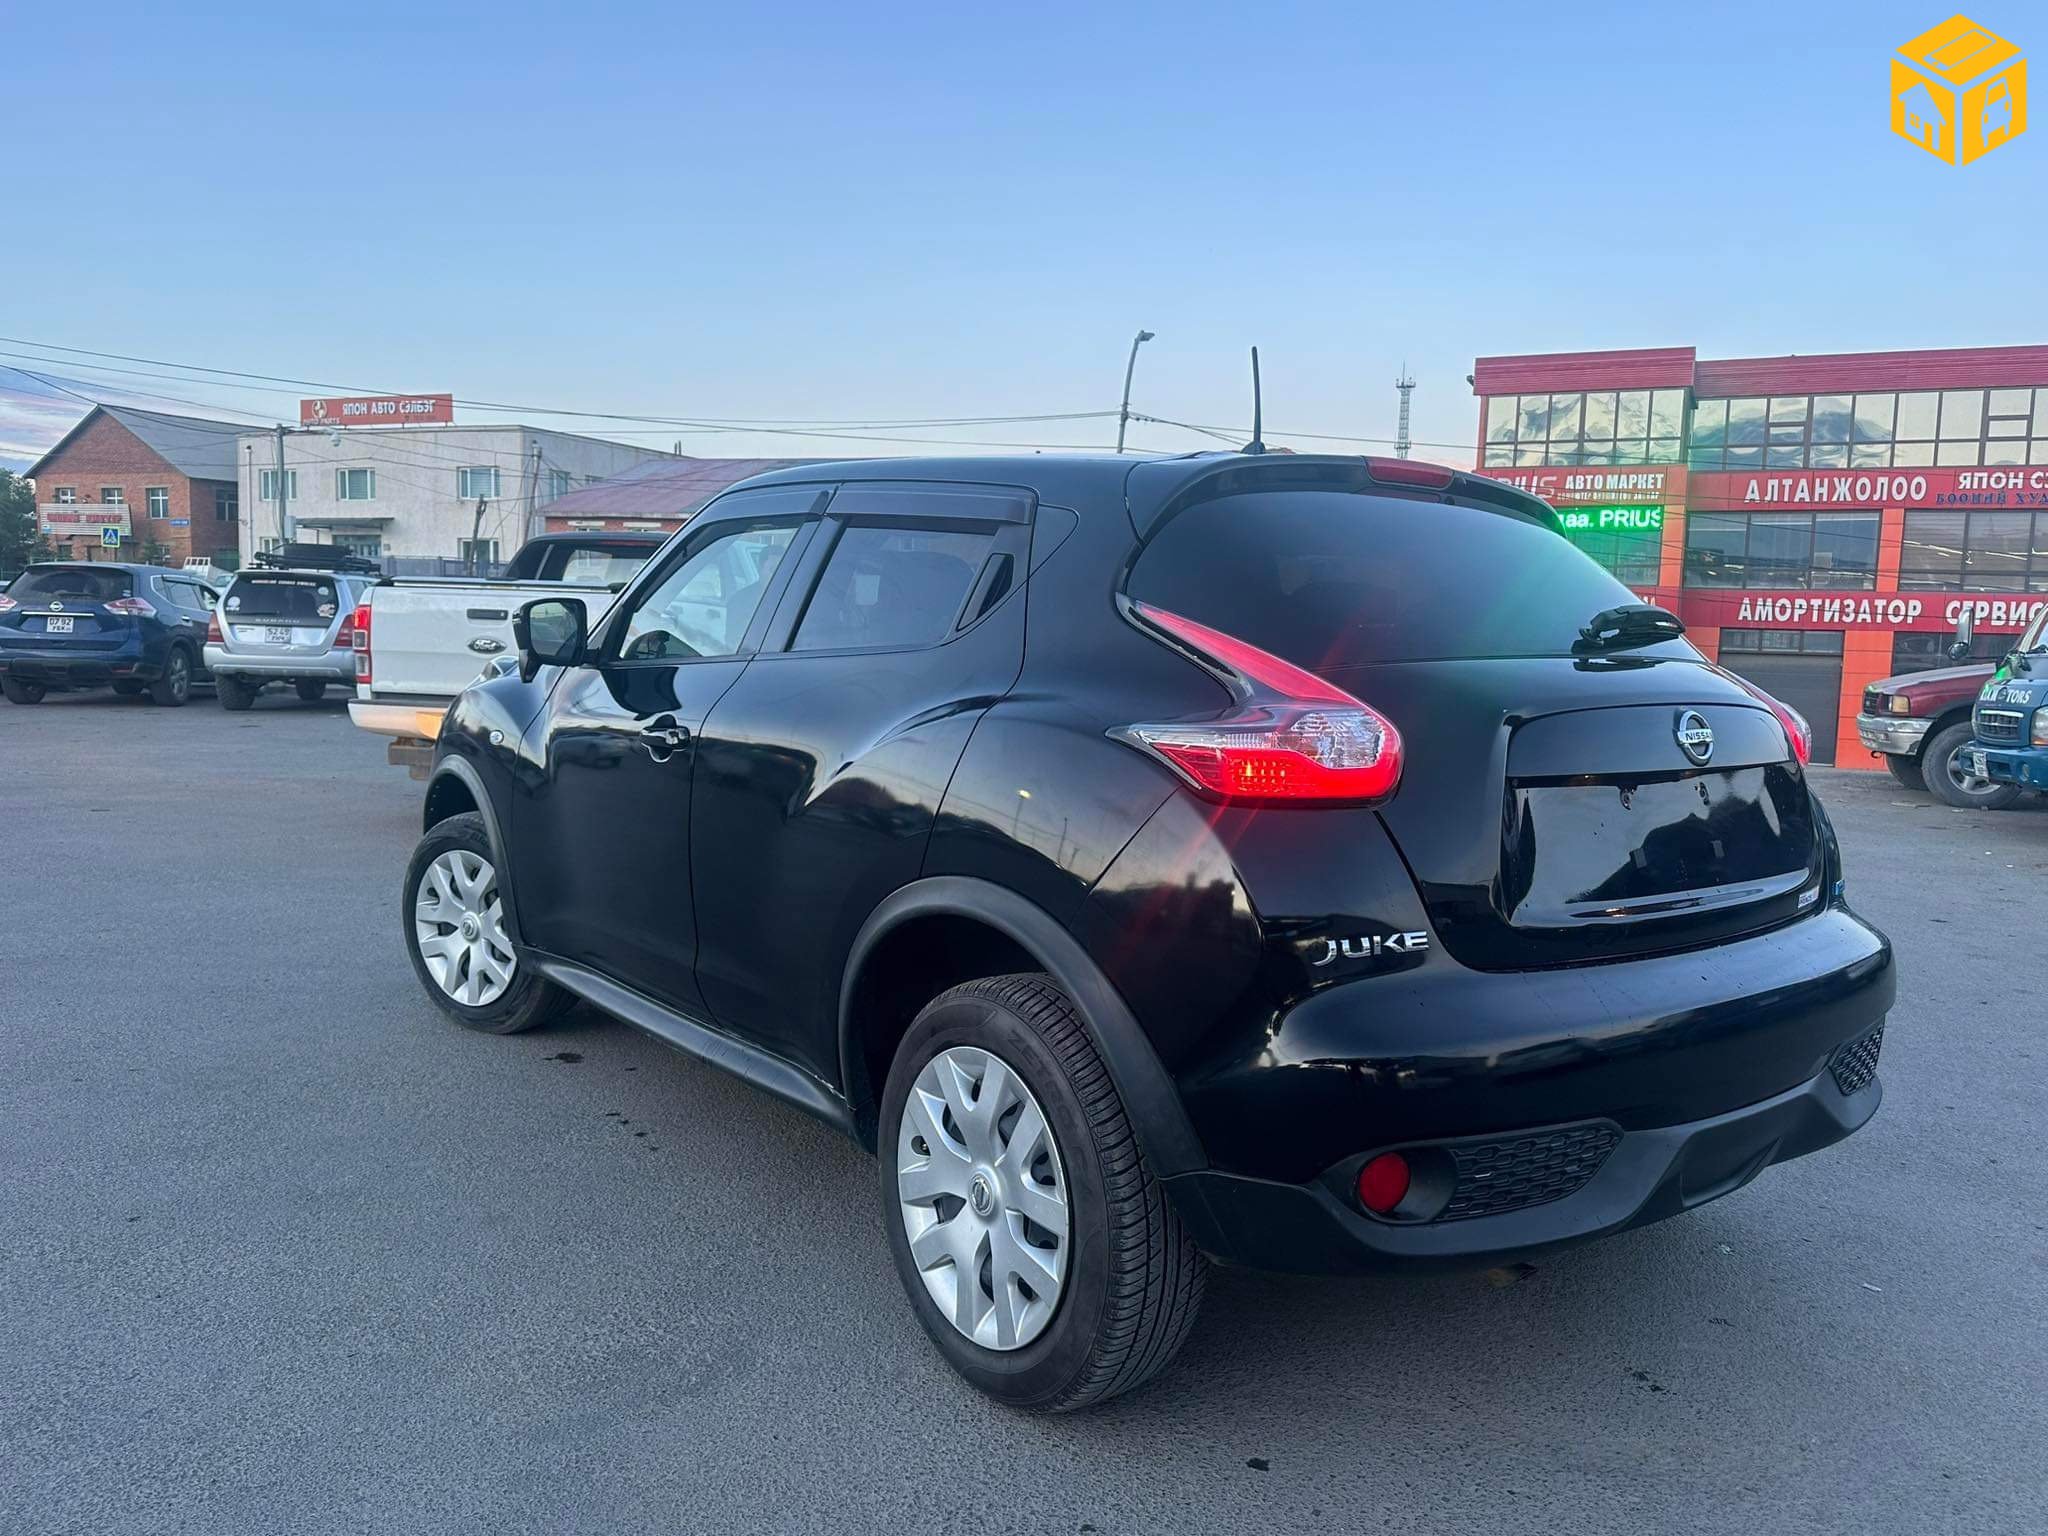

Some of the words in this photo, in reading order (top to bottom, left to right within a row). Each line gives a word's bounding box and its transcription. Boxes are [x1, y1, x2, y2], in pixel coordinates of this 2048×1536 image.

[342, 403, 367, 416] ЯПОН
[371, 402, 396, 415] АВТО
[1488, 476, 1557, 500] IUS
[1565, 475, 1603, 490] АВТО
[1606, 474, 1664, 489] МАРКЕТ
[1744, 476, 1927, 503] АЛТАНЖОЛОО
[1957, 472, 2024, 490] ЯПОН
[1599, 508, 1661, 528] PRIUS
[1738, 597, 1921, 625] АМОРТИЗАТОР
[1312, 931, 1429, 967] JUKE
